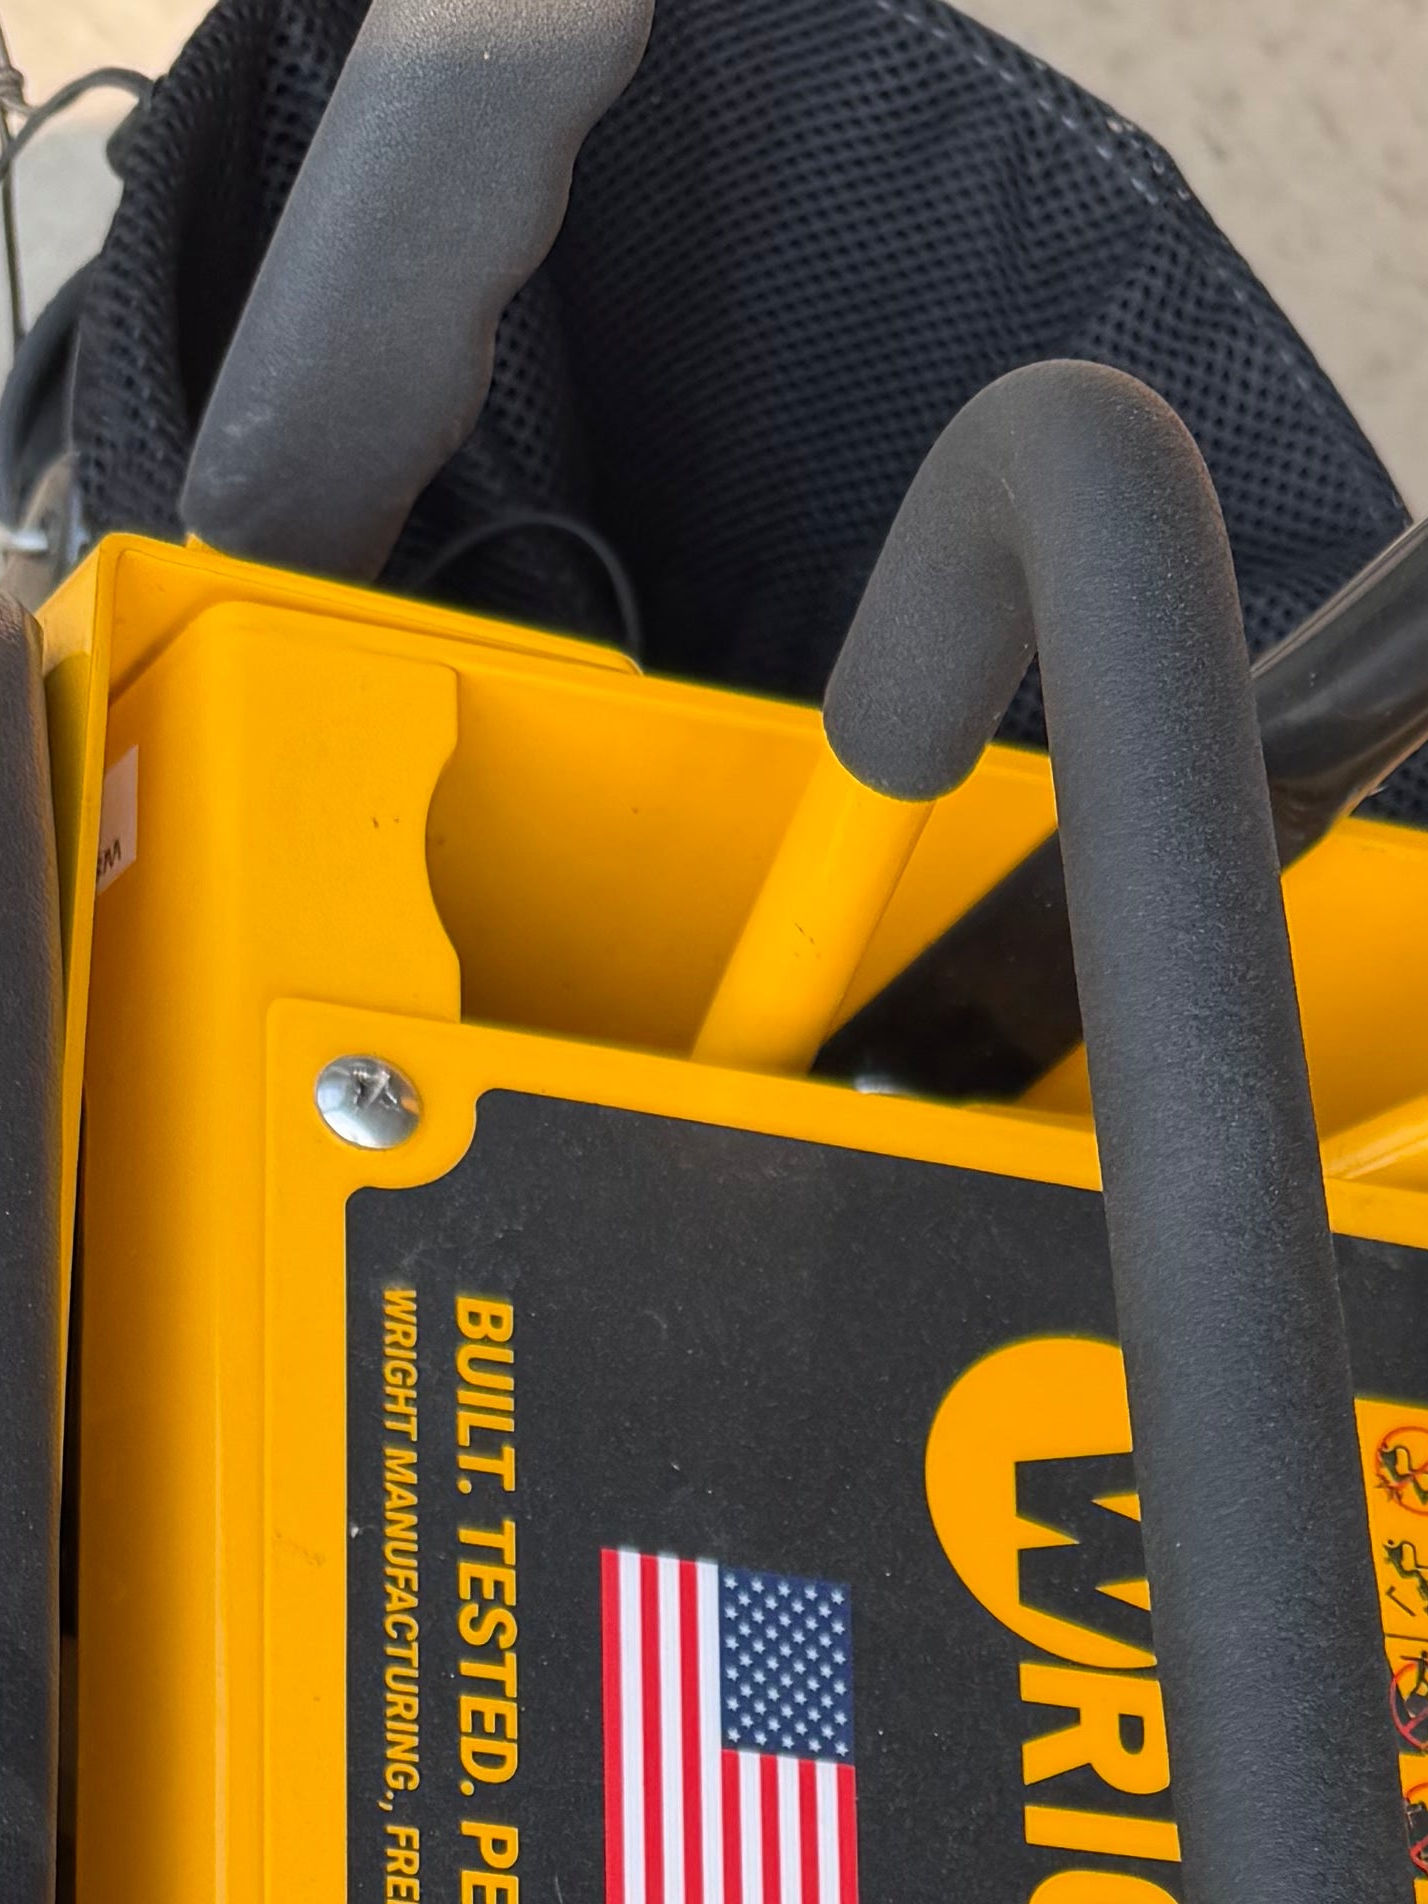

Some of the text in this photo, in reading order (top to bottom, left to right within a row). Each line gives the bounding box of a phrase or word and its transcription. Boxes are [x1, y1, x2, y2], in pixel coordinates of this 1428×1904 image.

[383, 1288, 417, 1442] WRIGHT
[455, 1296, 515, 1494] BUILT.
[378, 1448, 420, 1811] MANUFACTURING.,
[458, 1519, 518, 1796] TESTED.
